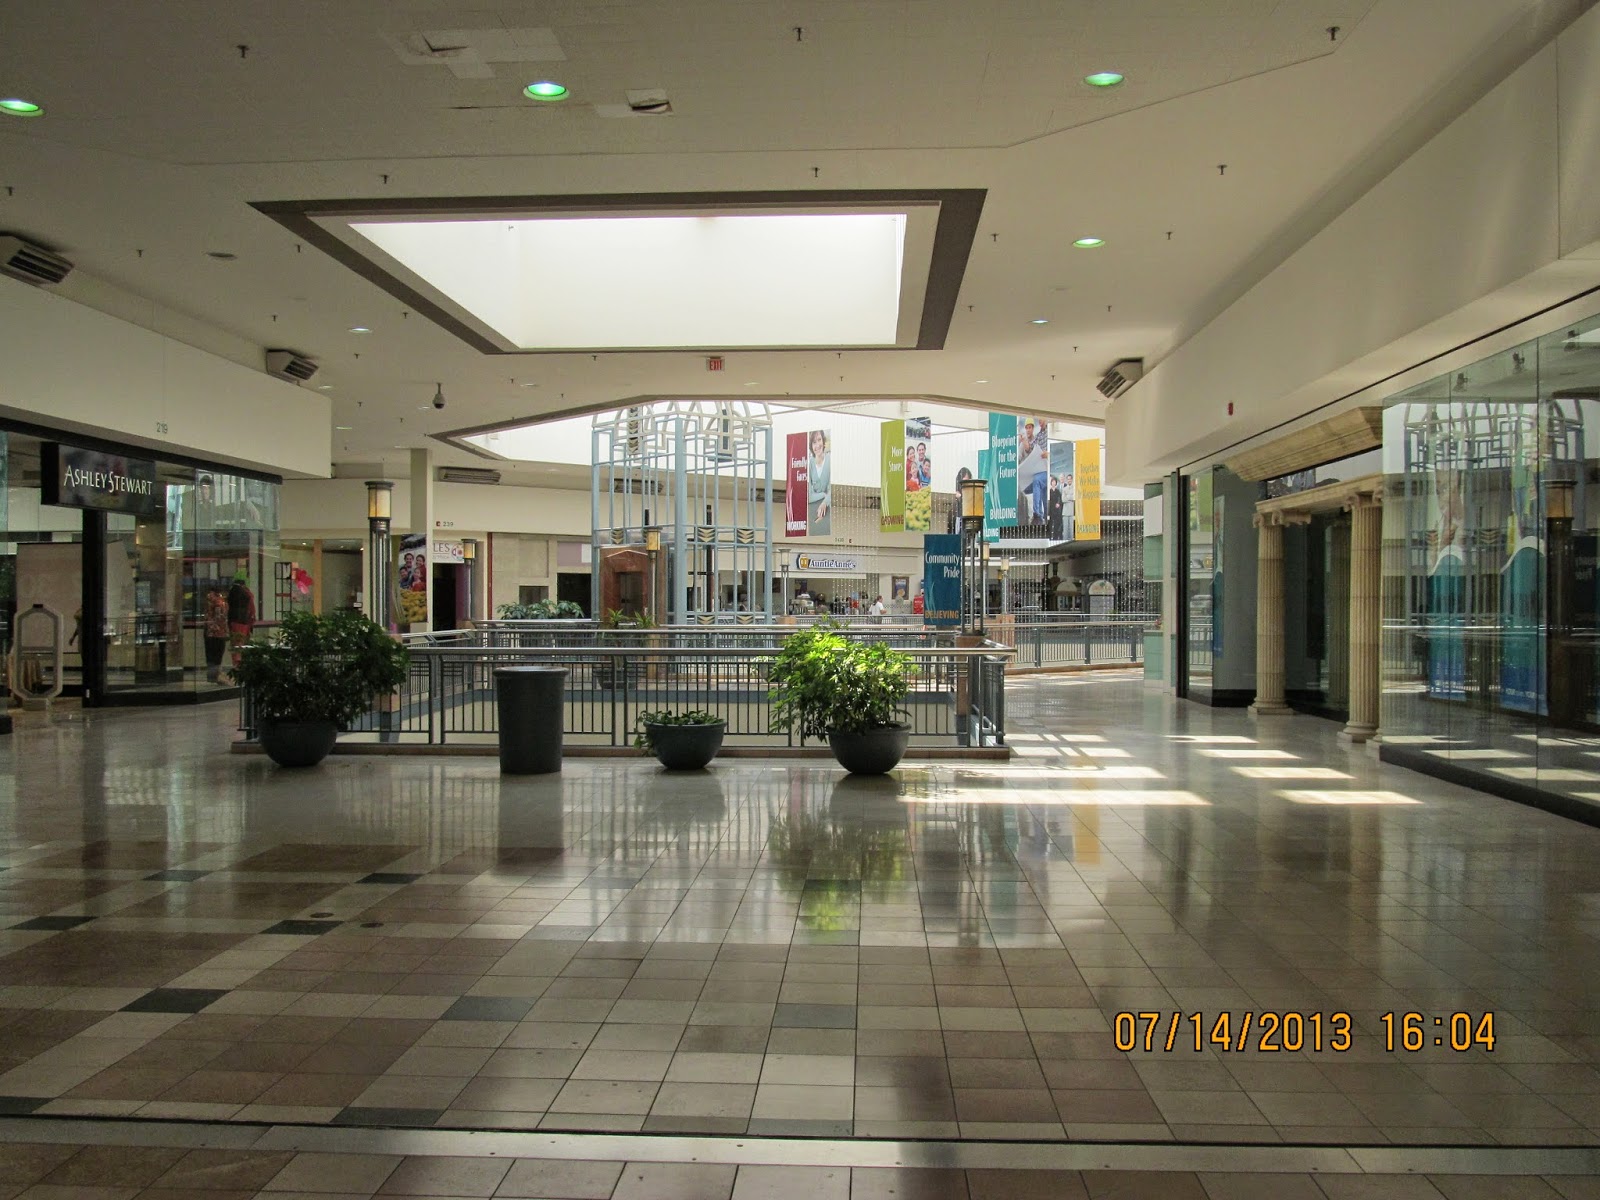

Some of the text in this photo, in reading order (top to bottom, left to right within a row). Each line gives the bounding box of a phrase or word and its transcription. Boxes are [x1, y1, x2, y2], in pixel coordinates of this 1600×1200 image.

[710, 360, 721, 370] EXIT
[156, 422, 168, 434] 219
[992, 435, 1016, 449] Blueprint
[891, 446, 903, 457] More
[998, 449, 1016, 463] for the
[791, 456, 808, 469] Friendly
[888, 461, 903, 472] Stores
[999, 465, 1016, 478] Future
[63, 464, 153, 495] ASHLEY STEWART
[990, 507, 1016, 520] BUILDING
[881, 514, 904, 526] GROWING
[786, 521, 807, 532] WORKING
[810, 559, 833, 568] Auntie
[925, 551, 960, 566] Community
[943, 565, 960, 578] Pride
[925, 610, 959, 619] BELIEVING
